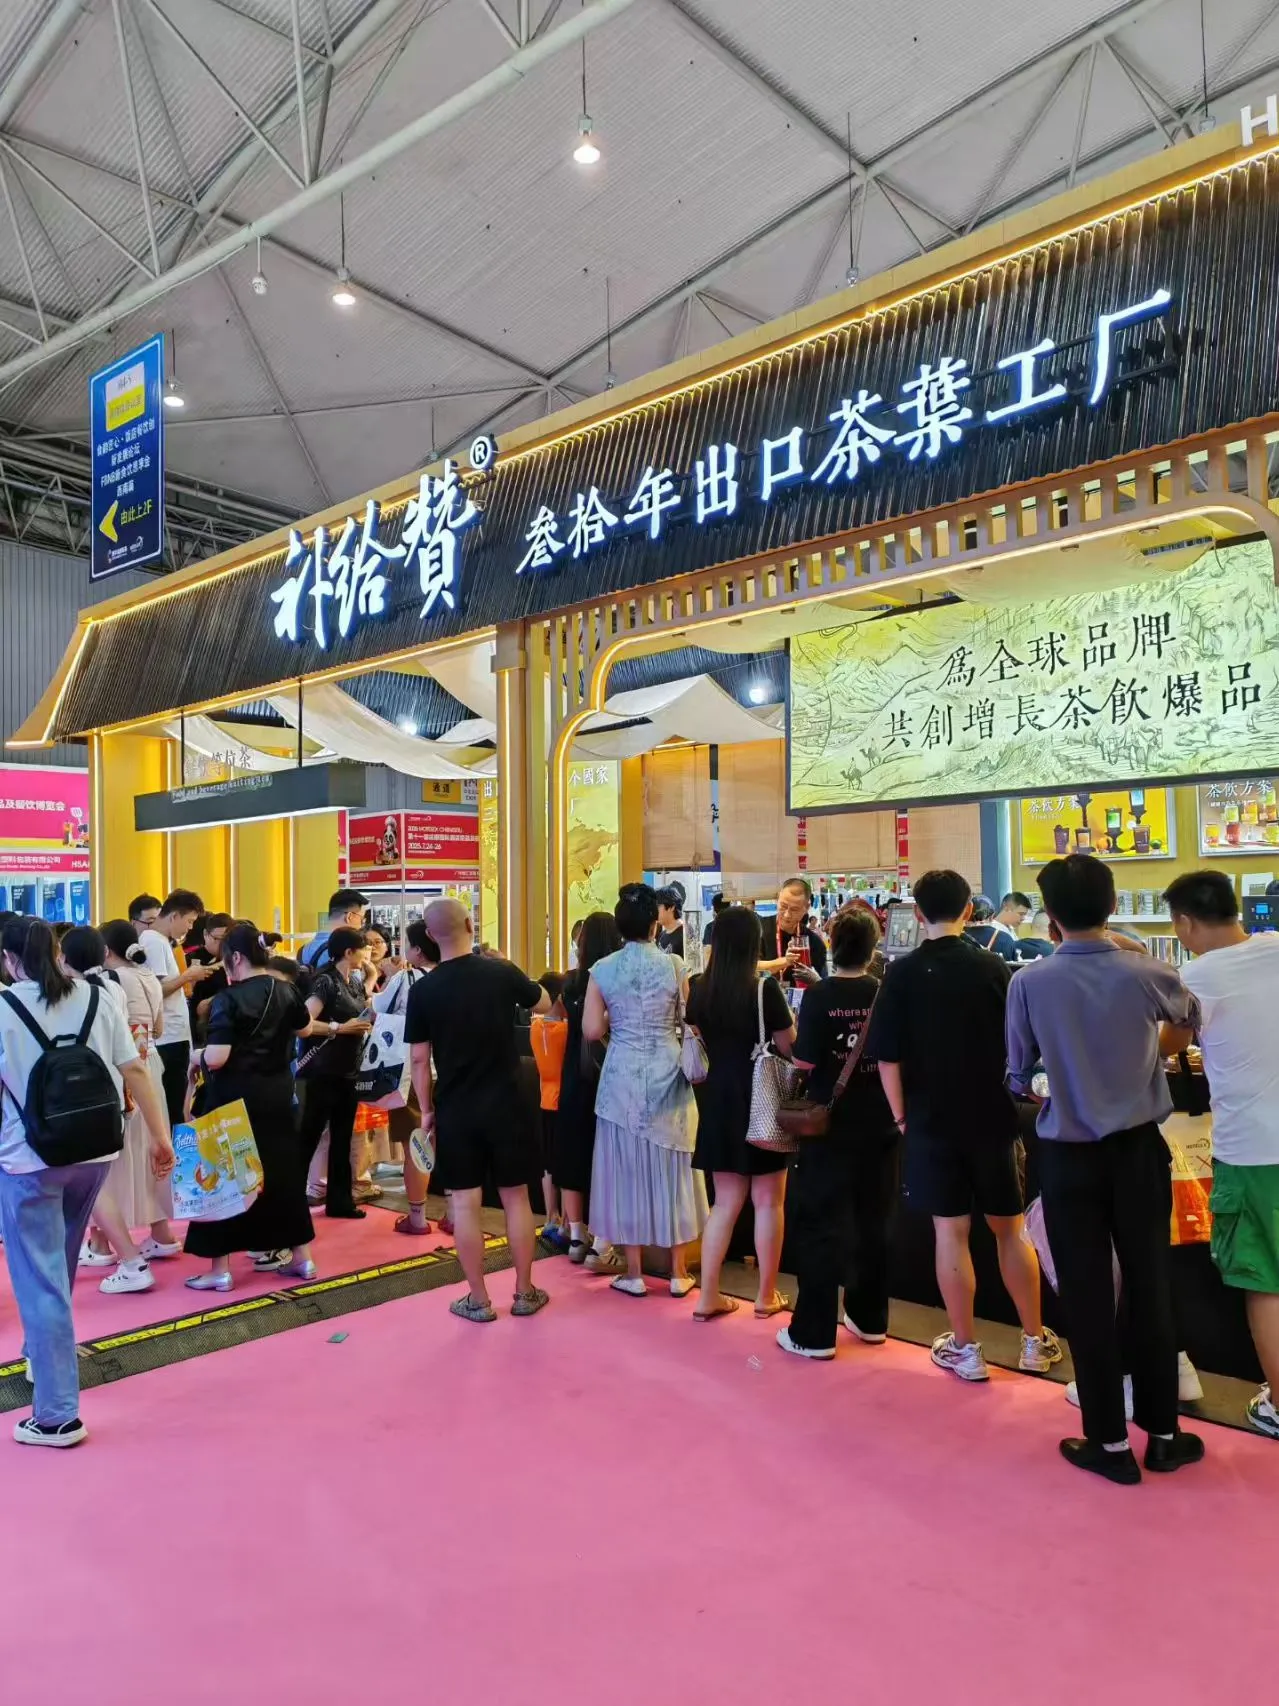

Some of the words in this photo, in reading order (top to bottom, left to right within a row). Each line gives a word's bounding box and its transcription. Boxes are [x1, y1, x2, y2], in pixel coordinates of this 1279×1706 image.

[121, 499, 152, 525] 由此上2F
[828, 1008, 860, 1017] where
